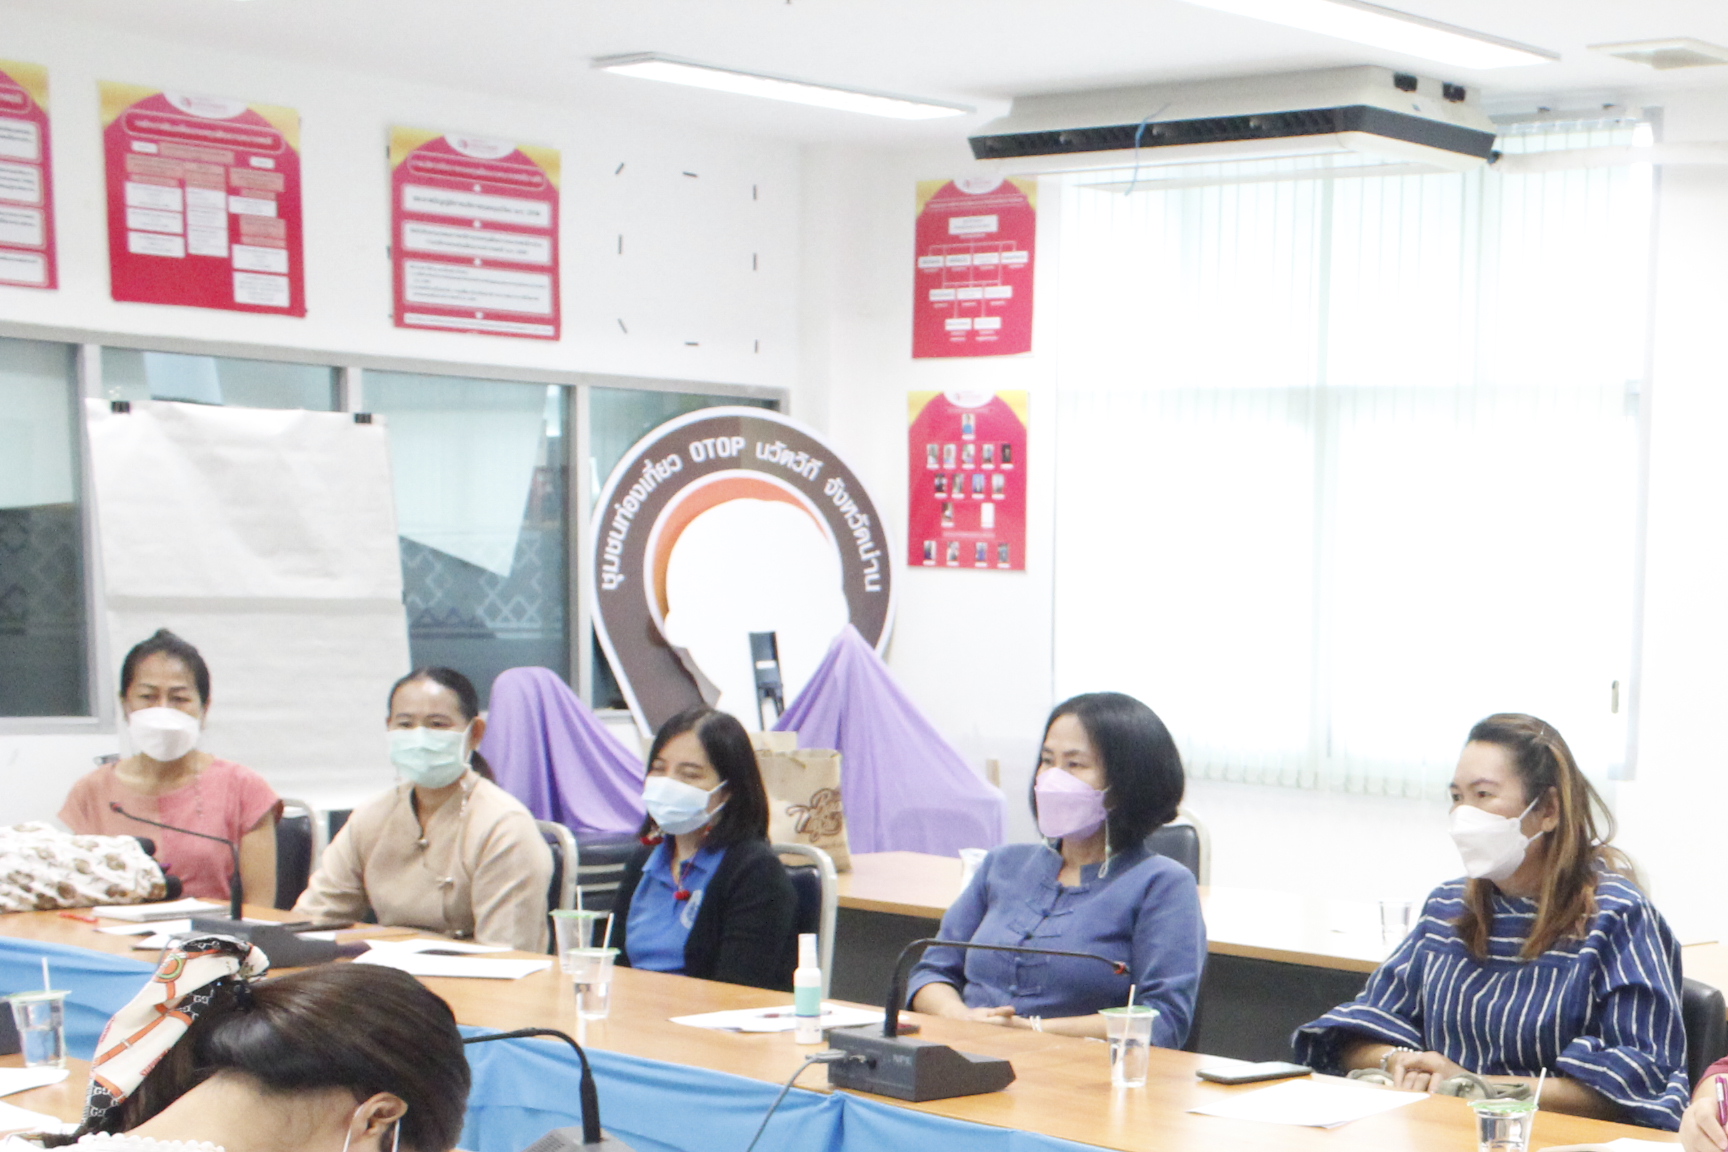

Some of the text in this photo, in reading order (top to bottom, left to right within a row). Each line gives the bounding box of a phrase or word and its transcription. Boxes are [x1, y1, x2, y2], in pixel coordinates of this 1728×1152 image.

[601, 436, 882, 592] ชุมชนท่องเที่ยว OTOP นวัตวิถี จังหวัดน่าน
